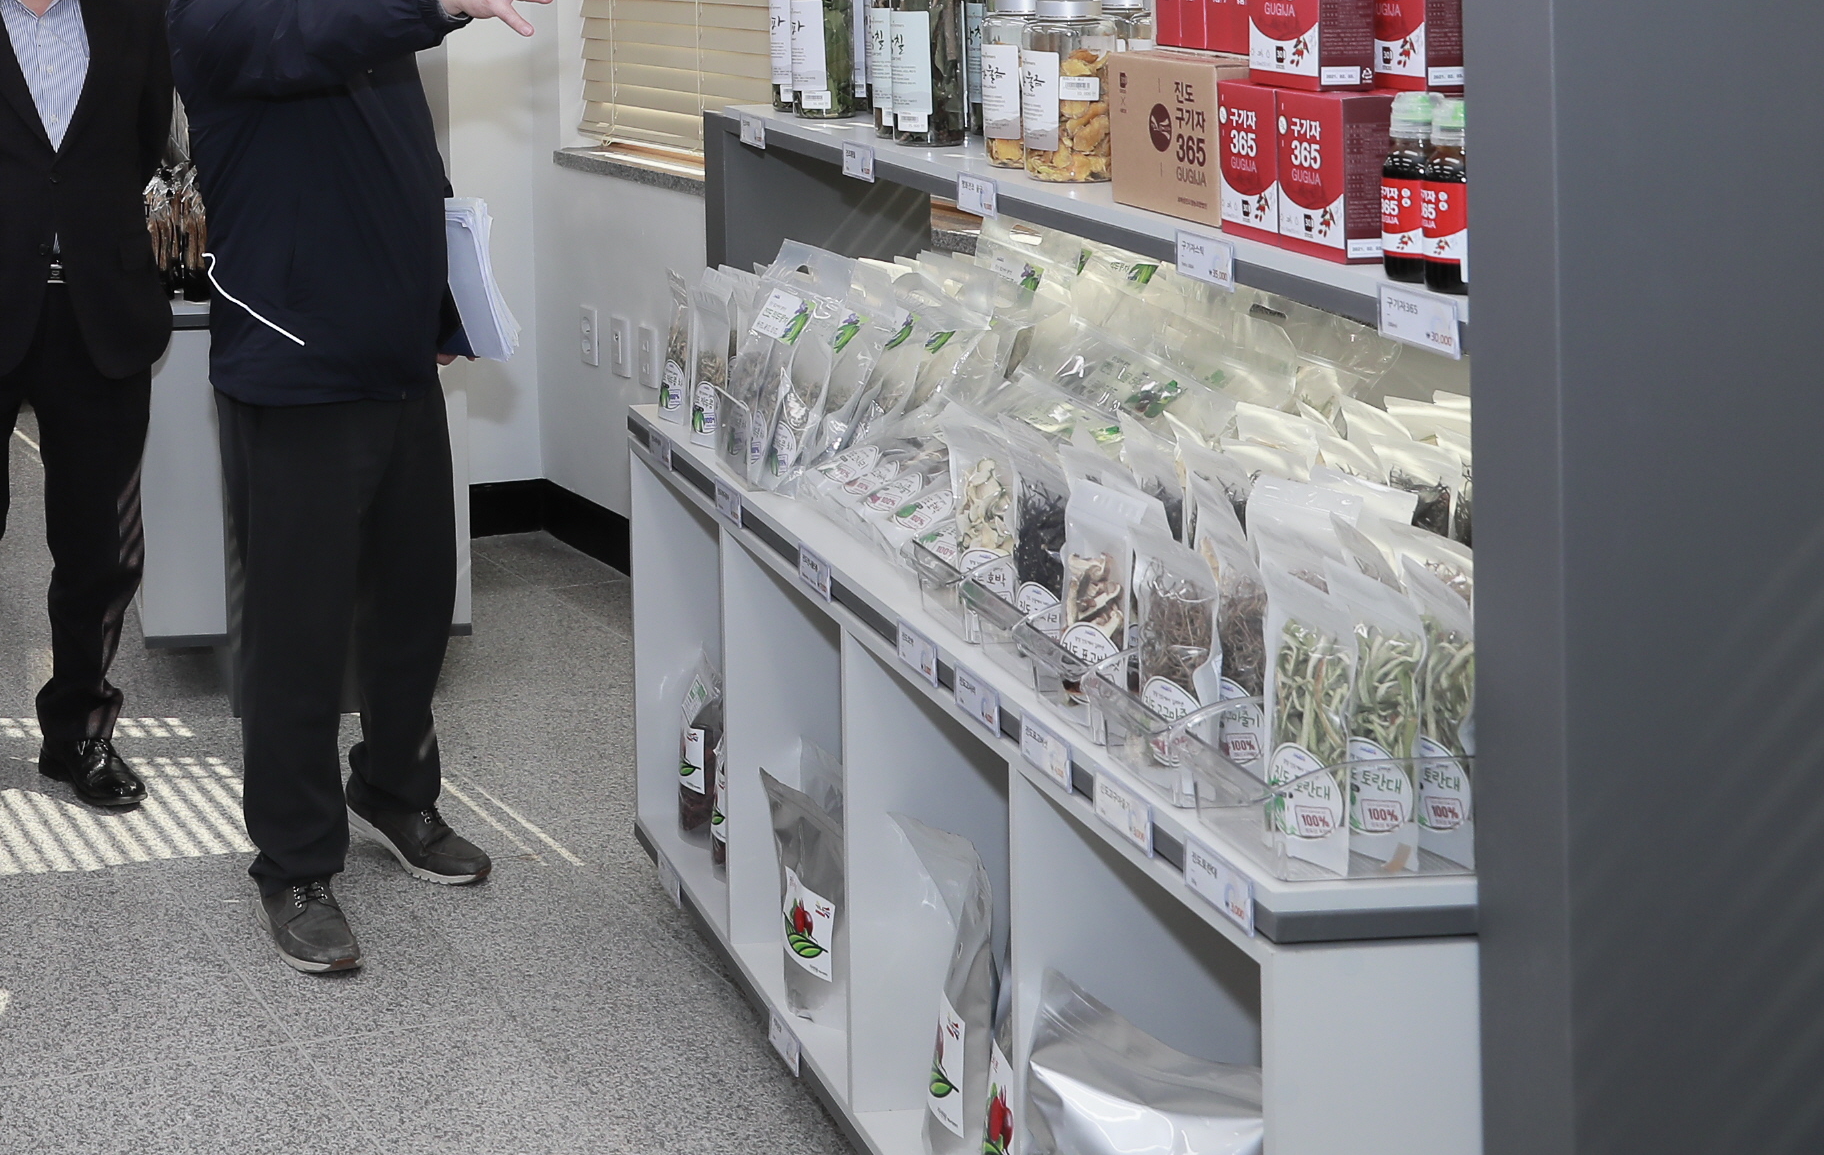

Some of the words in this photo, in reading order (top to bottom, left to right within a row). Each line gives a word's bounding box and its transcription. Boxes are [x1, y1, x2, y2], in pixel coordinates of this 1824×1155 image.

[1264, 2, 1296, 17] GUGIJA
[1375, 3, 1402, 17] UGIJA
[1174, 81, 1195, 104] 진도
[1175, 107, 1206, 134] 구기자
[1229, 108, 1257, 130] 구기자
[1290, 117, 1321, 141] 구기자
[1175, 133, 1206, 167] 365
[1230, 129, 1257, 157] 365
[1230, 155, 1257, 174] GUGIJA
[1291, 139, 1321, 170] 365
[1176, 165, 1207, 187] GUGIJA
[1291, 167, 1321, 187] GUGIJA
[1421, 202, 1437, 220] 65
[1181, 240, 1205, 256] 구기자스틱
[1386, 296, 1418, 315] 구기자365
[936, 545, 956, 557] 100%
[986, 573, 1007, 588] 호박
[1223, 708, 1260, 728] 구마줄기
[1231, 739, 1255, 751] 100%
[1361, 770, 1403, 795] 토란대
[1424, 766, 1461, 792] 토란대
[1300, 813, 1330, 828] 100%
[1367, 807, 1399, 822] 100%
[1431, 804, 1459, 819] 100%
[1192, 850, 1218, 879] 진도토란대
